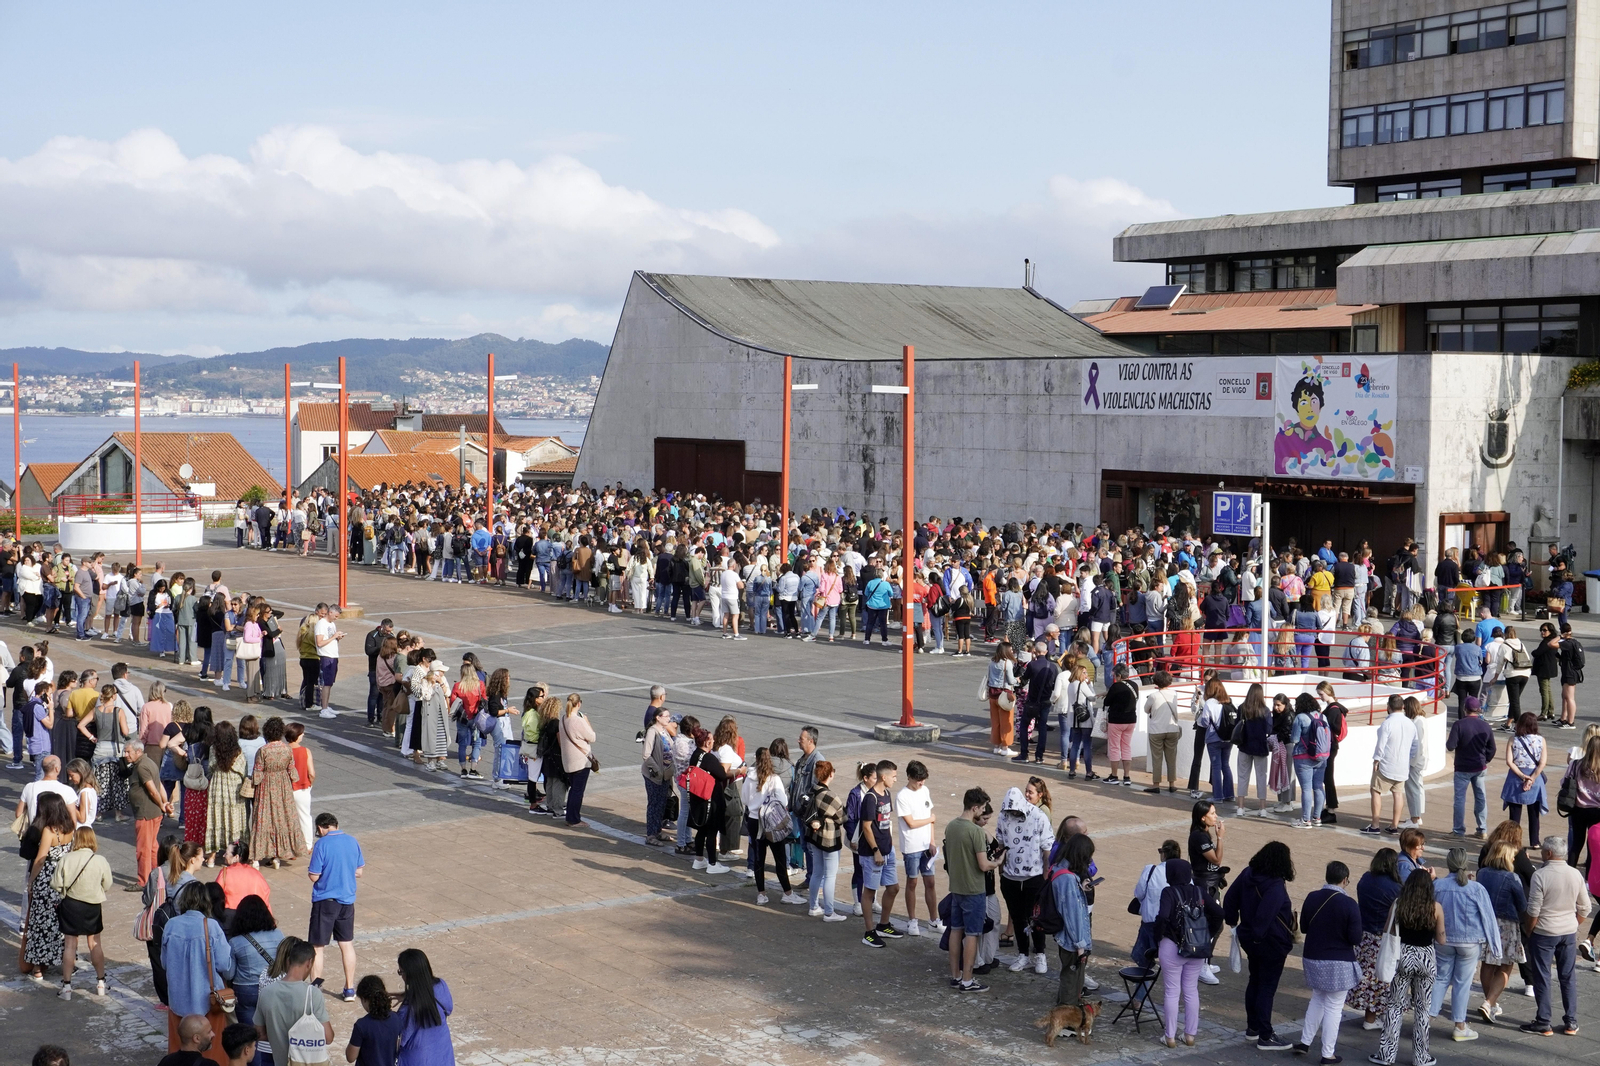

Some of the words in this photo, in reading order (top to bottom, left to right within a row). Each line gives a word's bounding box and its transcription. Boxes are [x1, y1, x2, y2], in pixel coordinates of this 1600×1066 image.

[1119, 363, 1140, 380] VIGO
[1142, 363, 1178, 381] CONTRA
[1180, 363, 1193, 380] AS
[1218, 378, 1251, 386] CONCELLO
[1222, 386, 1231, 394] DE
[1232, 386, 1247, 394] VIGO
[1103, 392, 1157, 409] VIOLENCIAS
[1158, 392, 1212, 410] MACHISTAS
[1216, 496, 1231, 517] P
[289, 1037, 325, 1047] CASIO
